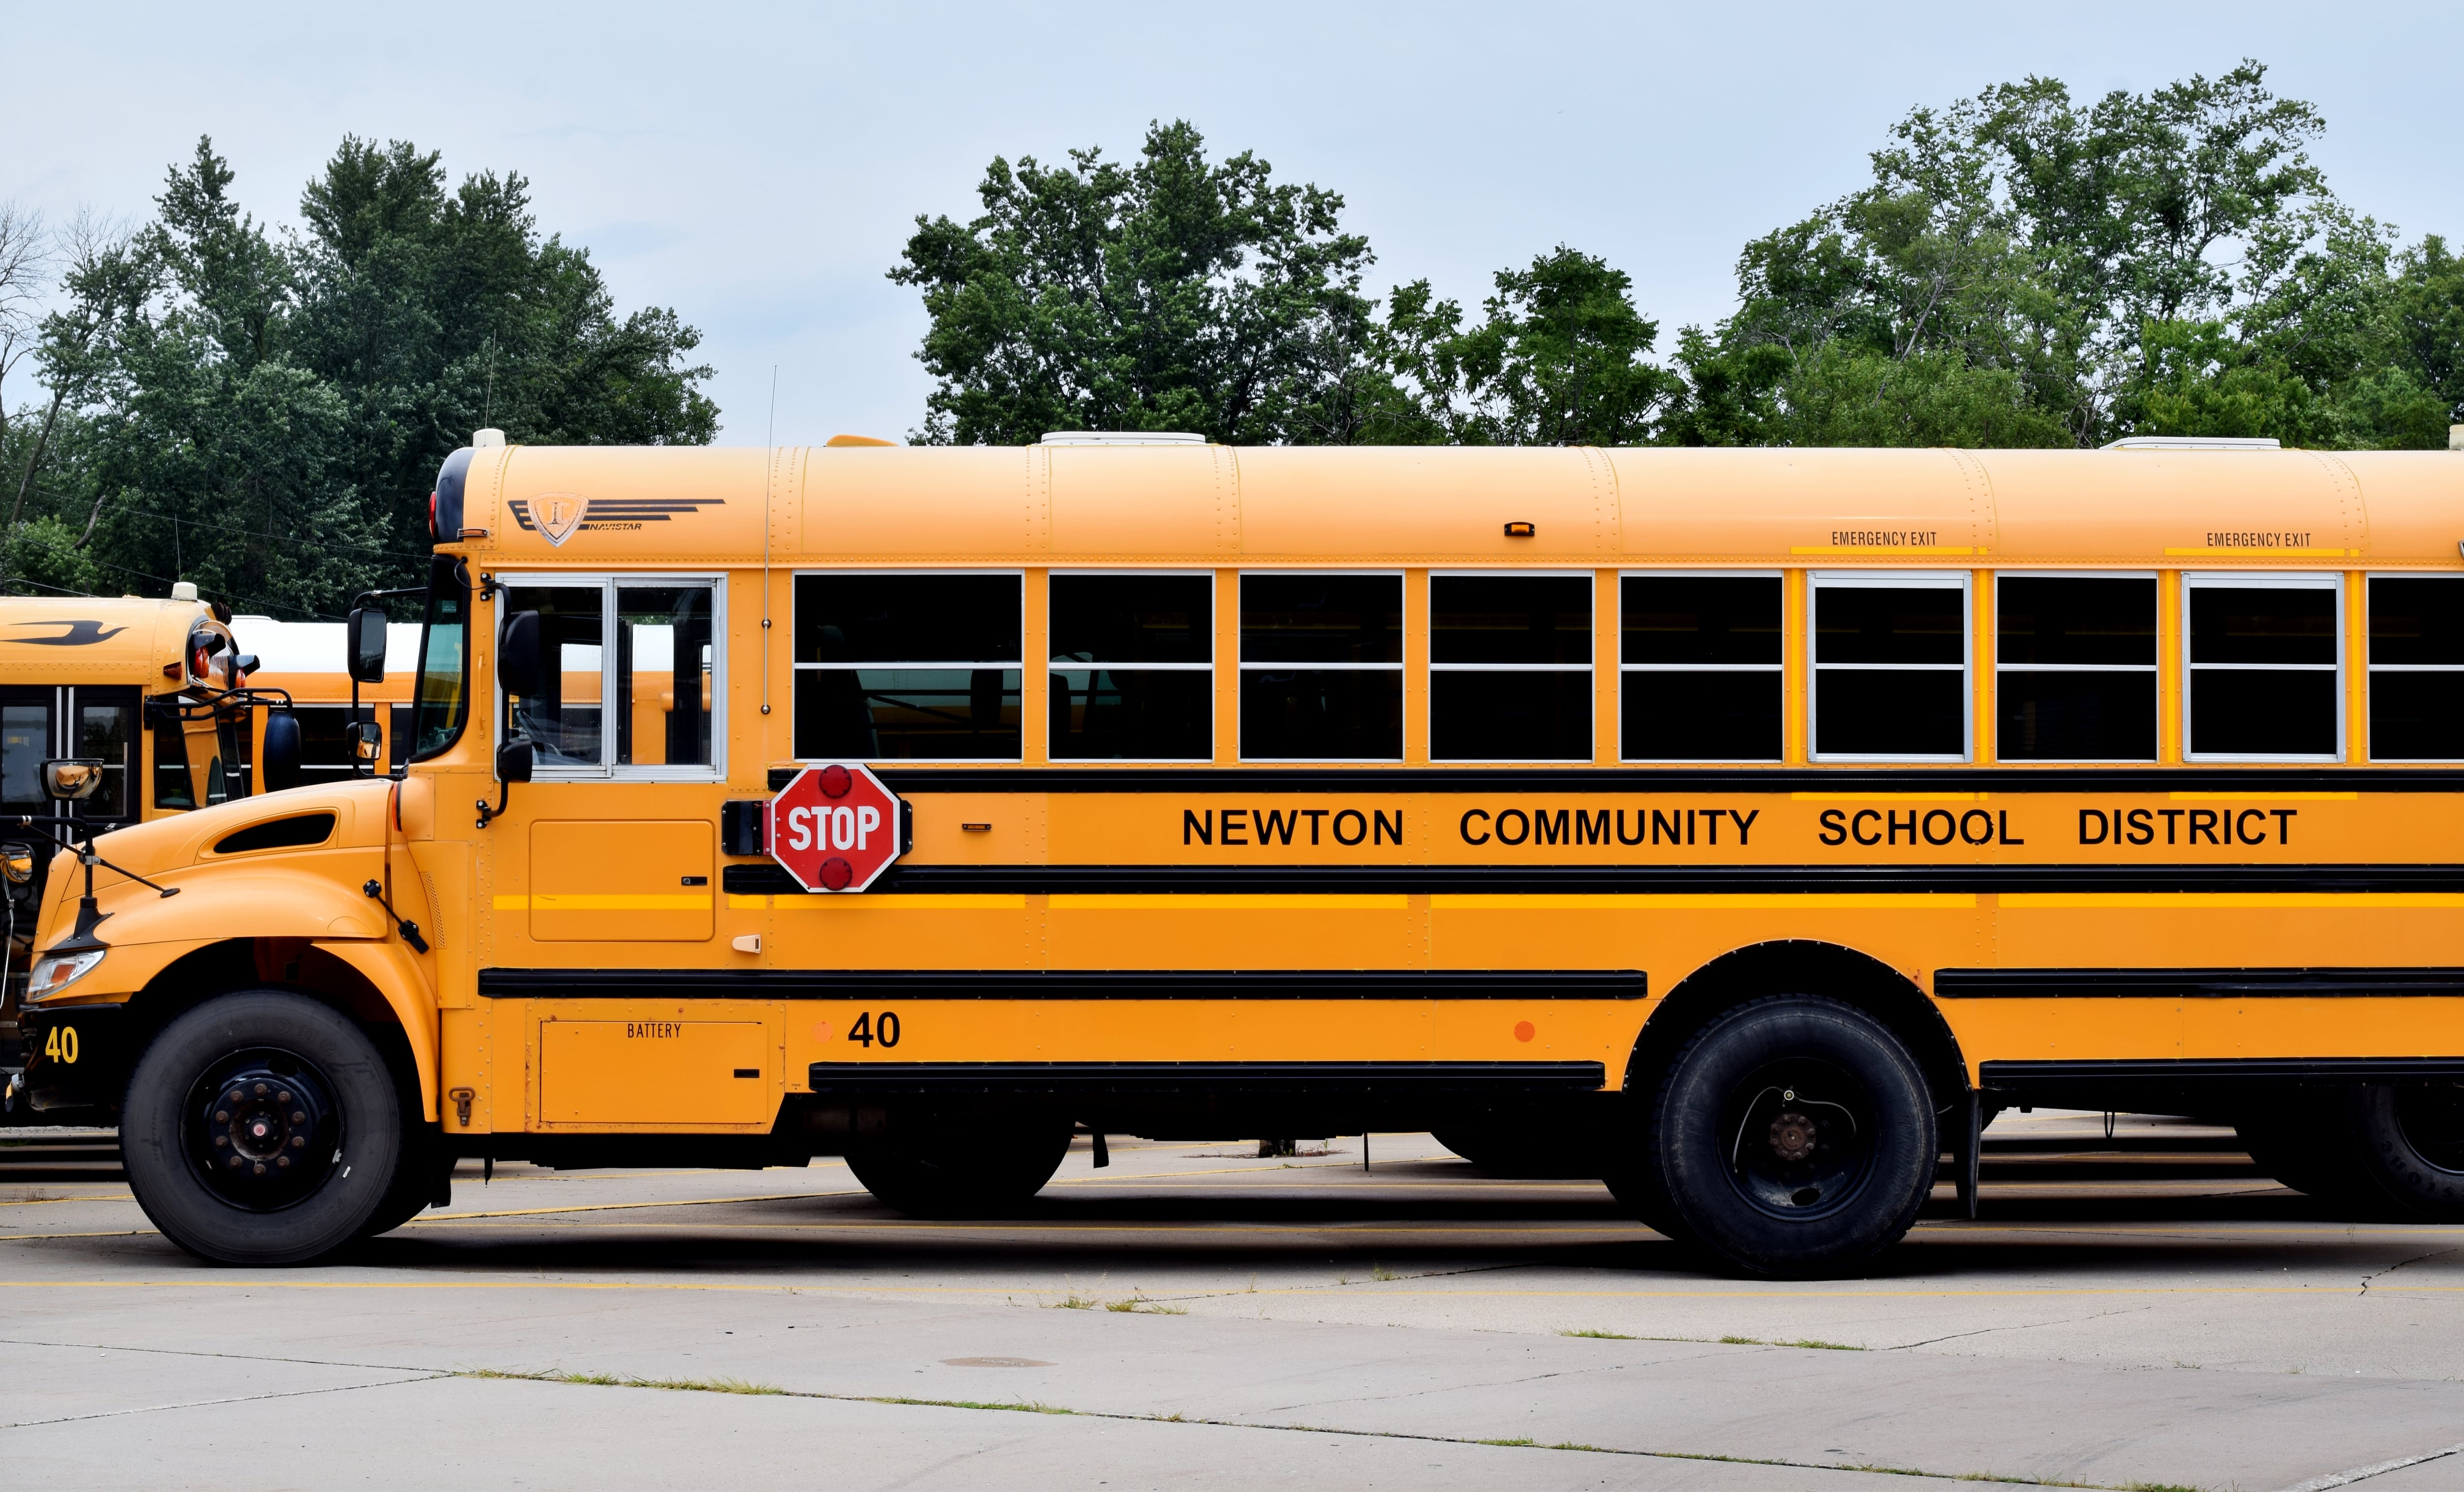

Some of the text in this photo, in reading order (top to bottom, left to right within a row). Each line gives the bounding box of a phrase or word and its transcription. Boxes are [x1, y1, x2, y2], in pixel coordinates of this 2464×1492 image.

[1832, 531, 1937, 546] EMERGENCY EXIT
[2207, 532, 2311, 547] EMERGENCY EXIT
[788, 806, 880, 851] STOP
[1184, 808, 2297, 846] NEWTON COMMUNITY SCHOOL DISTRICT
[45, 1026, 78, 1064] 40
[627, 1023, 683, 1038] BATTERY
[848, 1011, 900, 1048] 40
